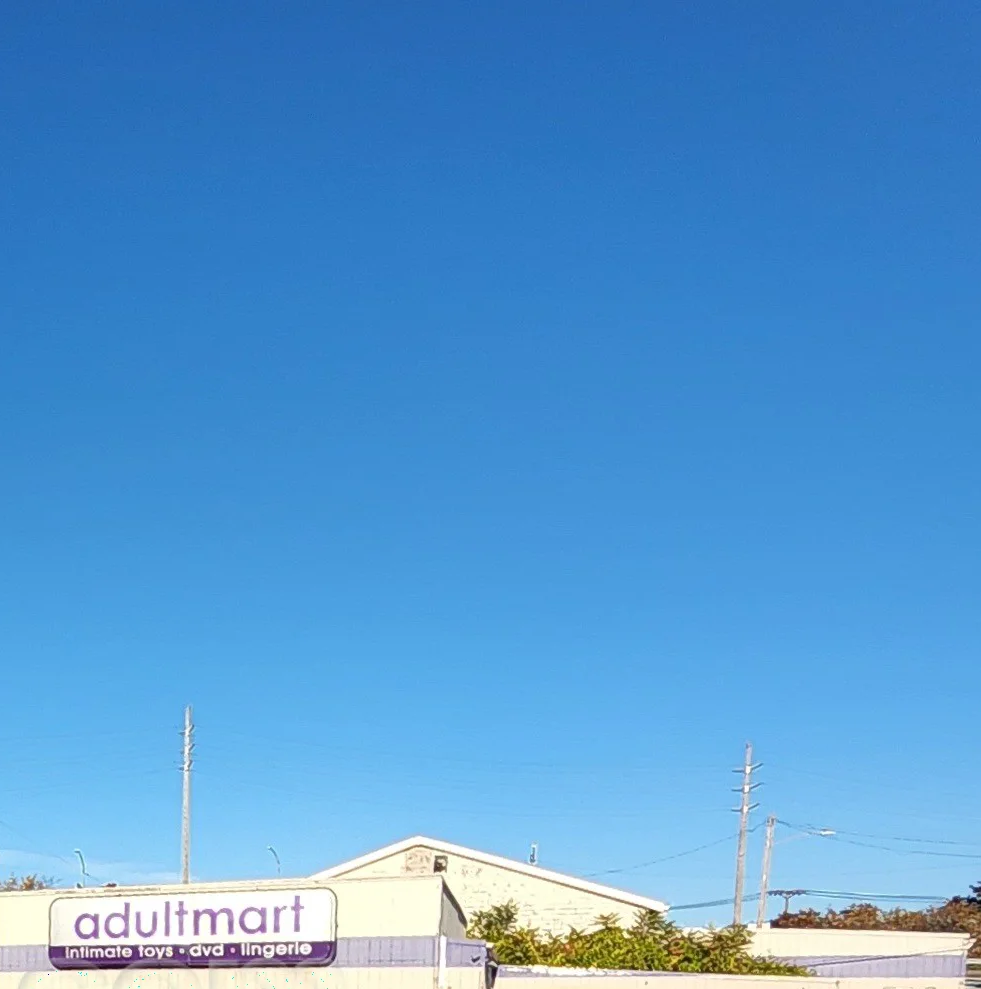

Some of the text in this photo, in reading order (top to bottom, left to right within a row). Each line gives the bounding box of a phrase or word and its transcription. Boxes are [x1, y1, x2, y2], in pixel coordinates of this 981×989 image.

[74, 895, 305, 940] adultmart
[65, 941, 313, 960] intimate toys dvd lingerie
